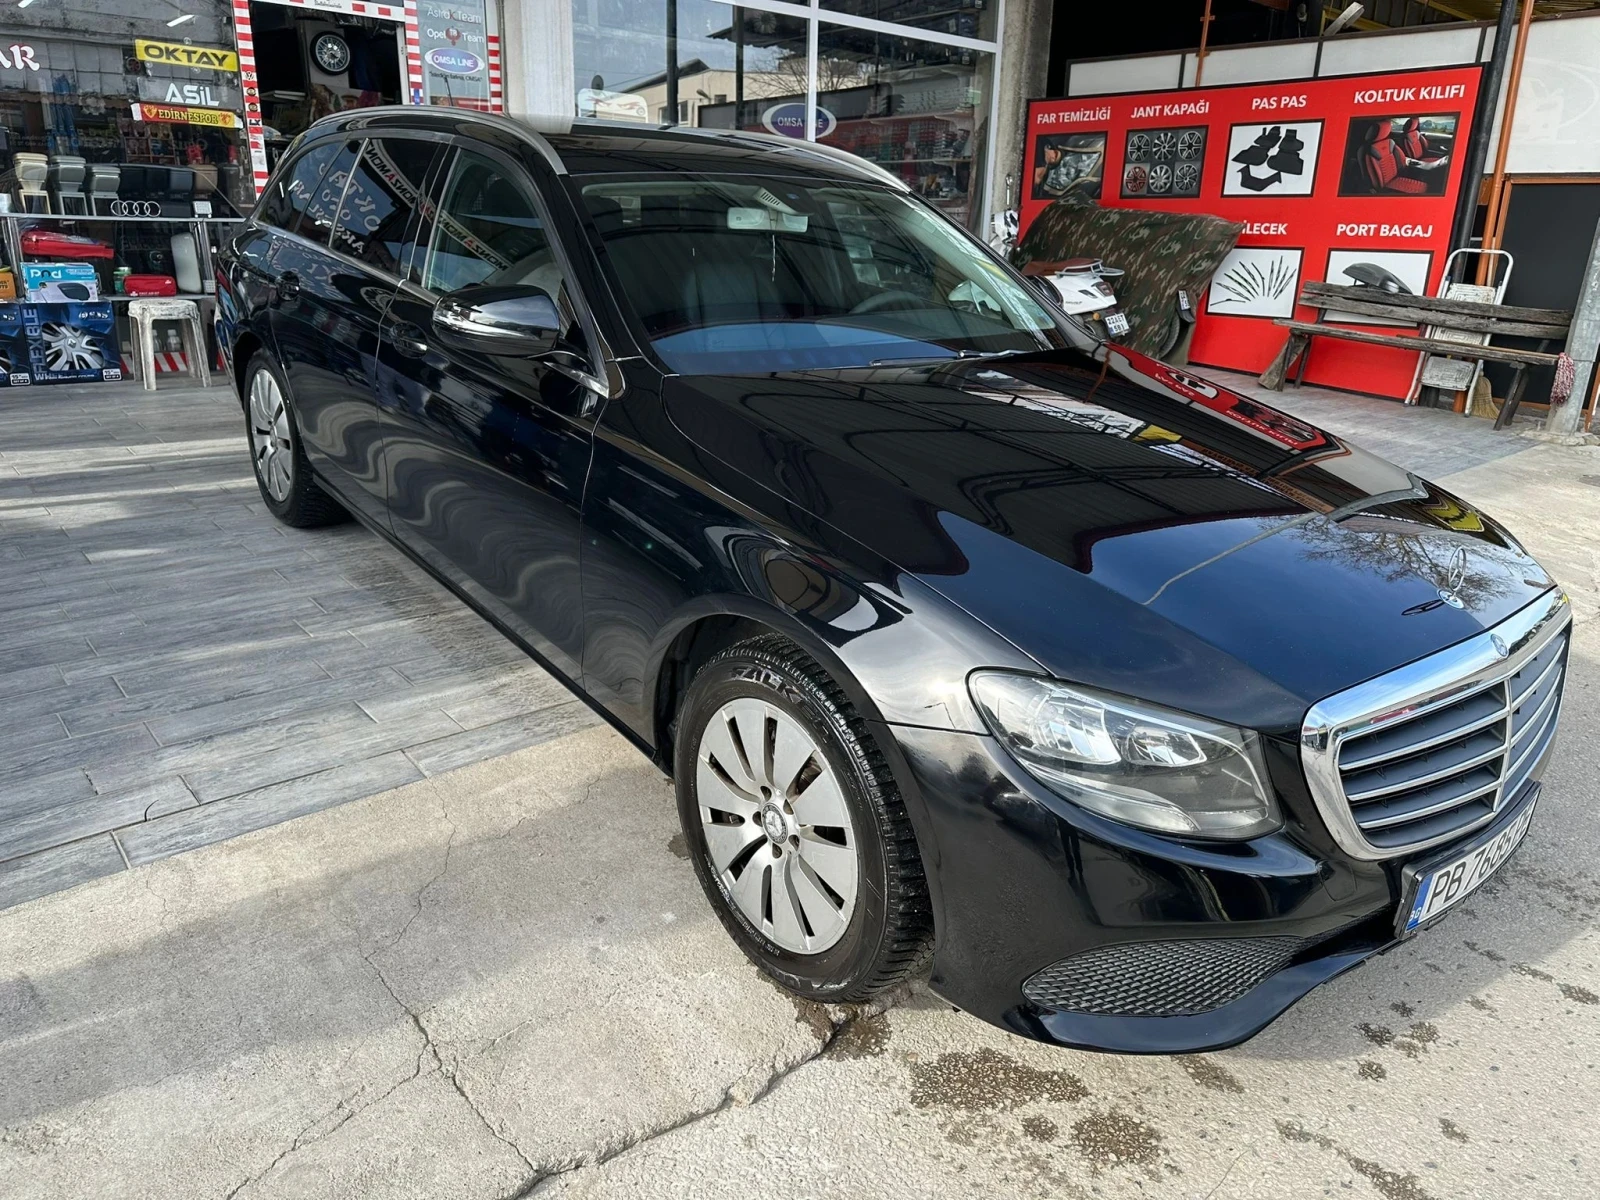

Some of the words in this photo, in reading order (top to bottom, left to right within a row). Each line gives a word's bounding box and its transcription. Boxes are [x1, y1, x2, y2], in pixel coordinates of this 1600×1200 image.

[427, 28, 446, 40] Opel
[462, 32, 484, 43] Team
[144, 44, 229, 68] OKTAY
[433, 54, 457, 66] OMSA
[457, 58, 475, 68] LINE
[1353, 87, 1417, 104] KOLTUK
[1419, 84, 1466, 100] KILIFI
[1131, 104, 1161, 119] JANT
[1164, 101, 1210, 116] KAPAĞI
[1252, 97, 1278, 110] PAS
[1280, 95, 1307, 108] PAS
[158, 109, 219, 125] EDİRNESPOR
[777, 117, 803, 127] OMSA
[1037, 111, 1056, 124] FAR
[1058, 107, 1111, 123] TEMİZLİĞİ
[1241, 220, 1288, 236] İLECEK
[1336, 223, 1377, 238] PORT
[1380, 223, 1433, 238] BAGAJ
[23, 308, 46, 374] FLEXIBLE
[1426, 862, 1467, 914] PB
